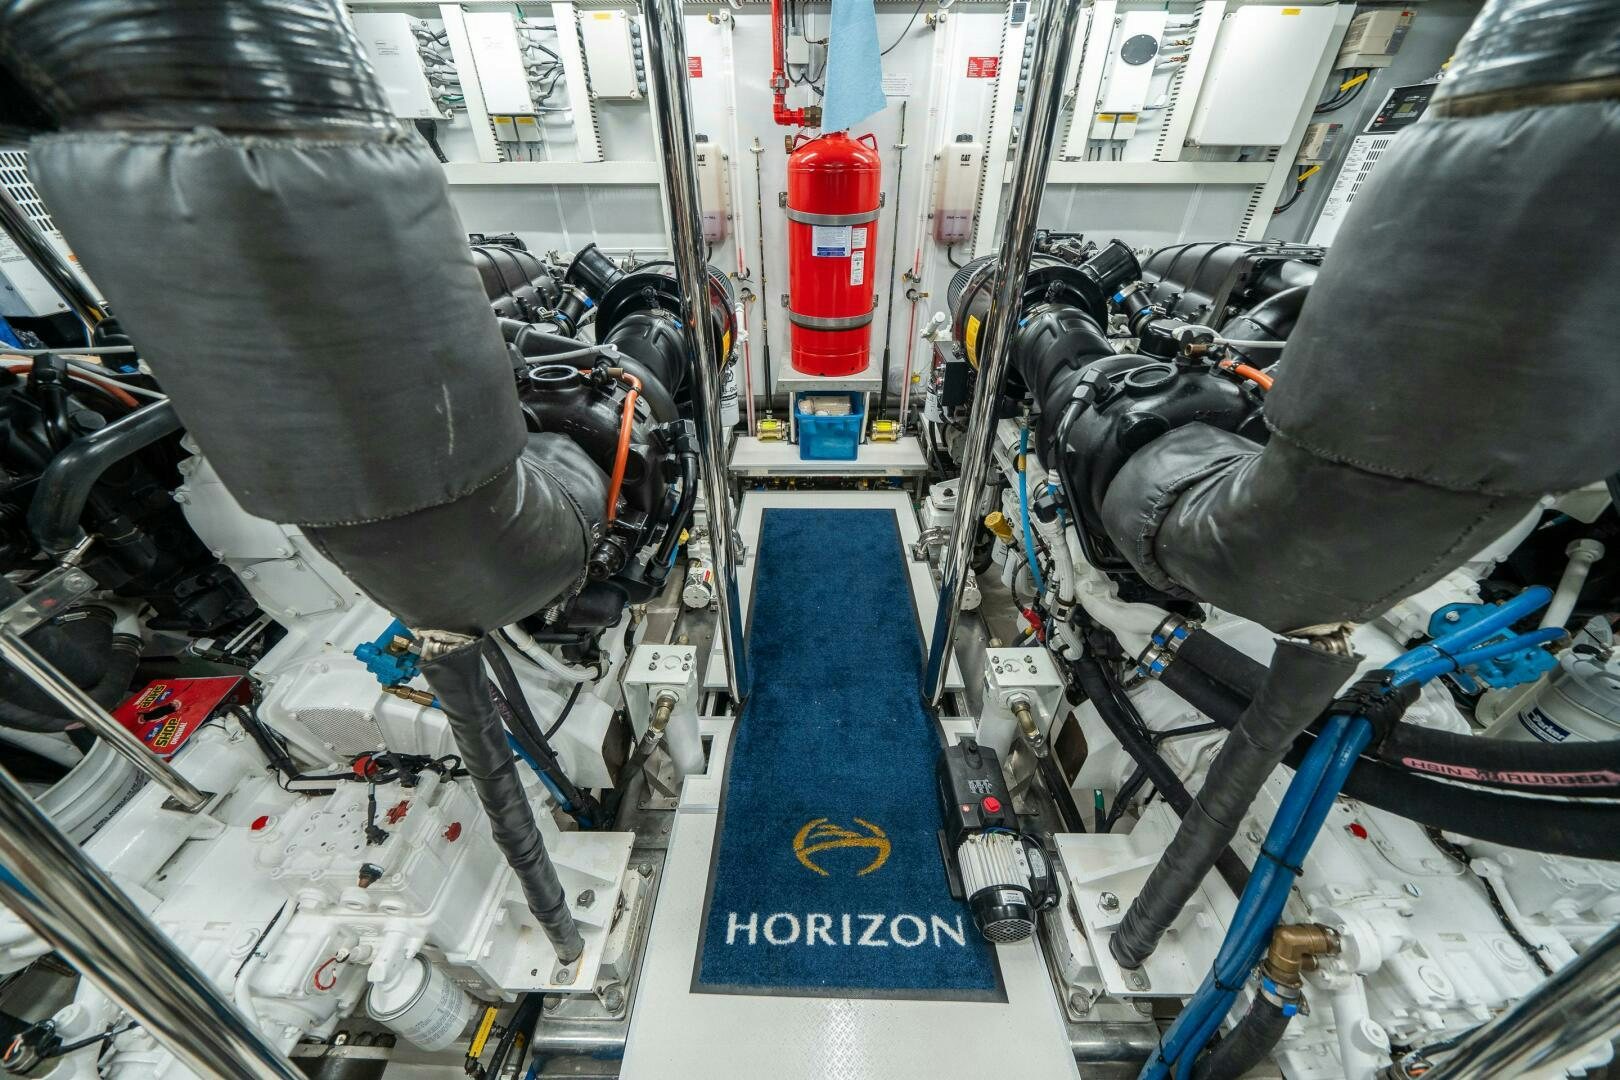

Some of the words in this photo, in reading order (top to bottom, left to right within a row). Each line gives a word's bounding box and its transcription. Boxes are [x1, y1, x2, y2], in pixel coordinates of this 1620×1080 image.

[960, 154, 971, 162] CAT
[154, 718, 179, 747] SHOP
[1532, 712, 1566, 740] Parker
[1507, 772, 1609, 785] RUBBER
[725, 911, 967, 948] HORIZON
